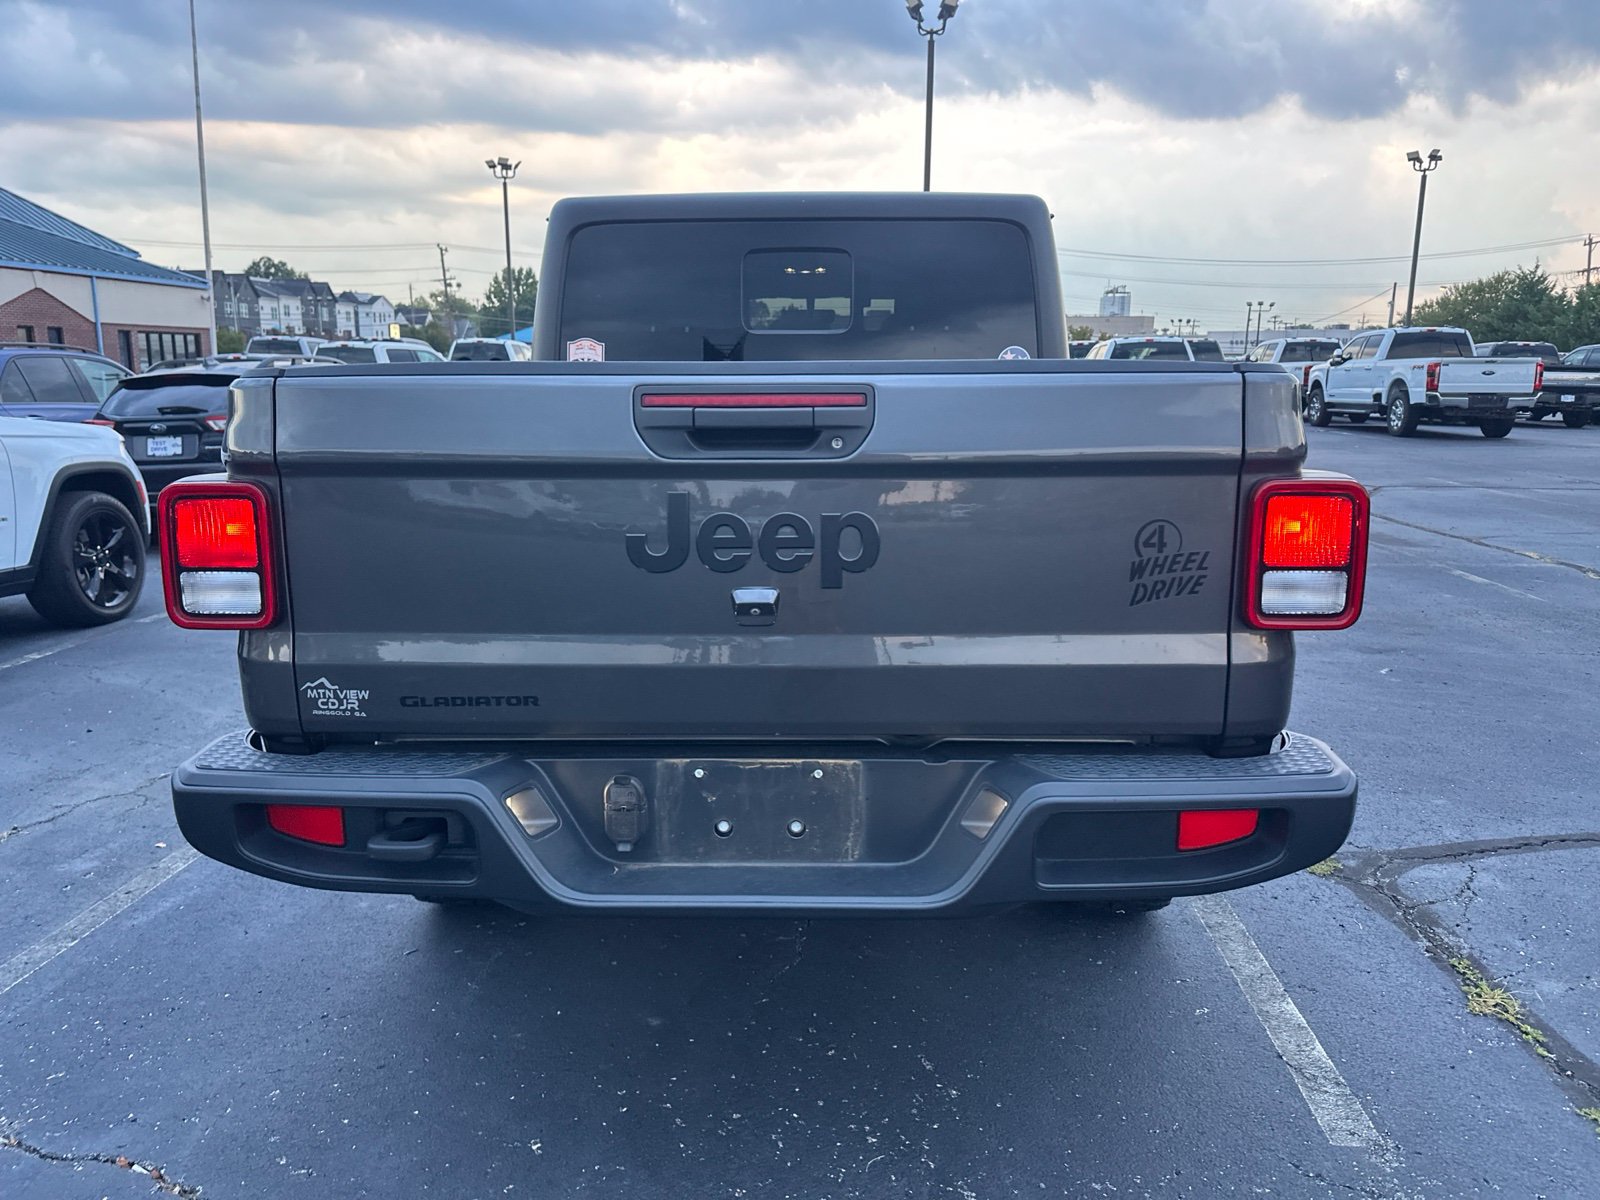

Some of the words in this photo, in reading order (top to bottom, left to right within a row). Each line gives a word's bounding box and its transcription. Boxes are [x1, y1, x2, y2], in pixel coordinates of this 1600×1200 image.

[625, 490, 881, 590] Jeep
[1142, 524, 1167, 554] 4
[1129, 551, 1210, 583] WHEEL
[1129, 574, 1208, 607] DRIVE
[307, 688, 334, 699] MTN
[336, 689, 370, 700] VIEW
[317, 698, 360, 710] CDJR
[400, 695, 539, 708] GLADIATOR
